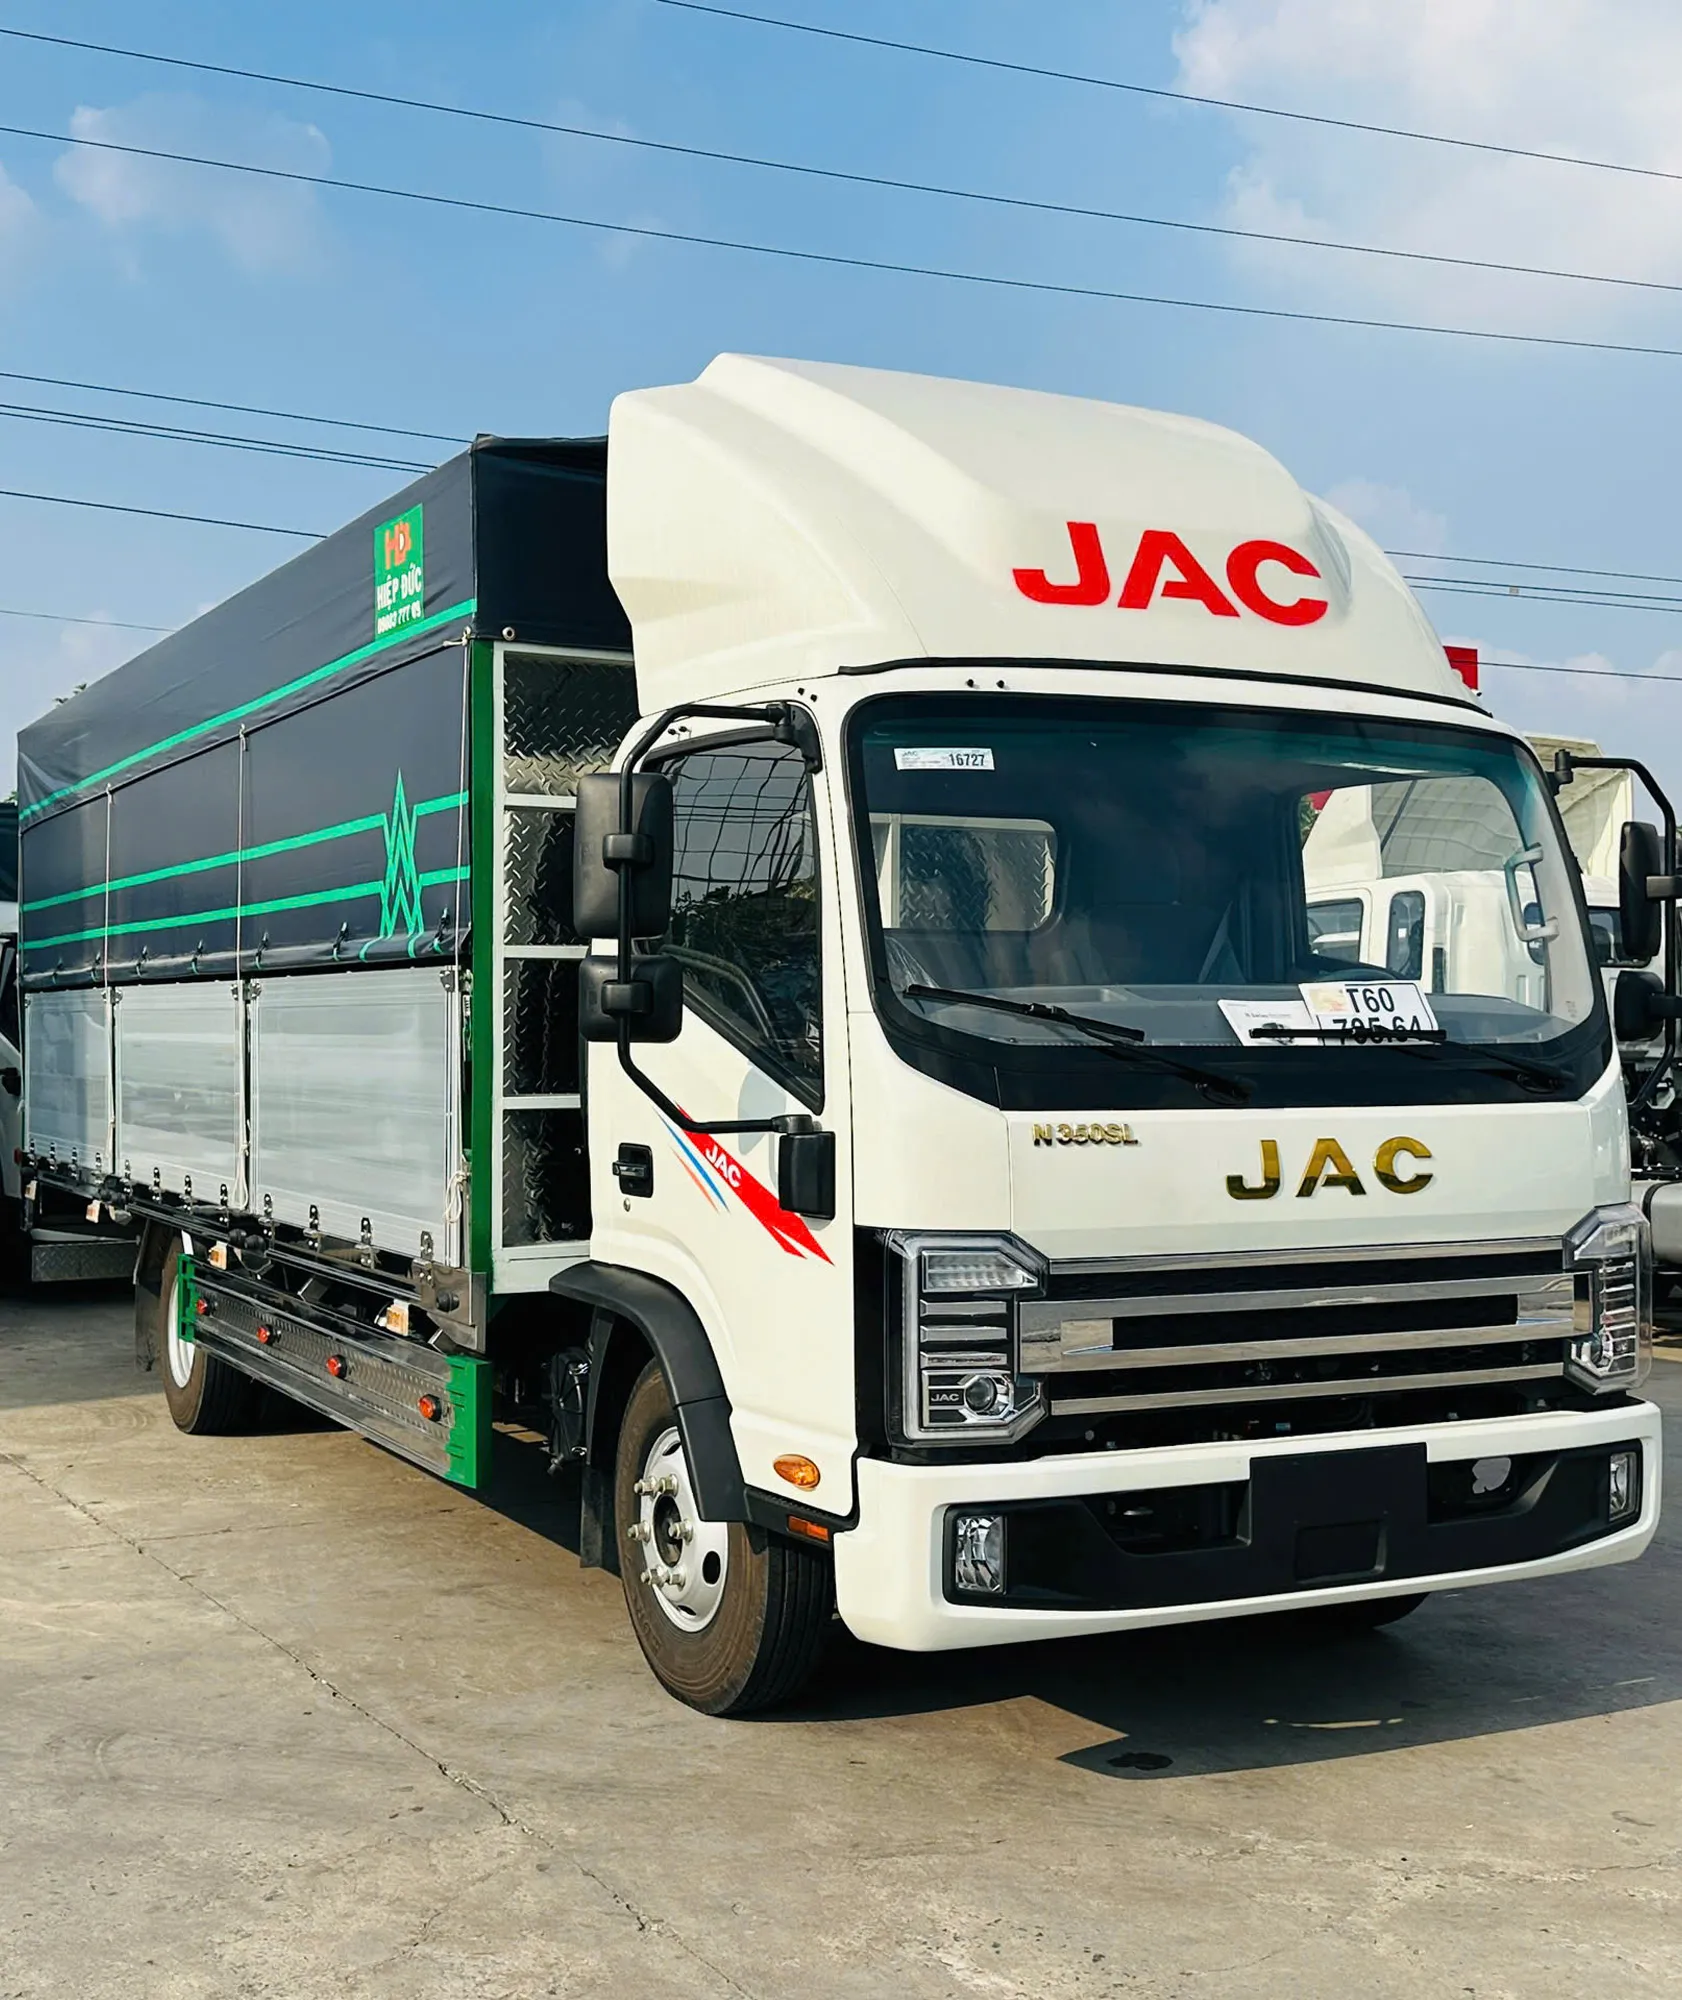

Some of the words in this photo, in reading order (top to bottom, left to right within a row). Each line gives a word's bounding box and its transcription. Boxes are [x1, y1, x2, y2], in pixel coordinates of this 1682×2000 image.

[377, 574, 399, 610] HIỆP
[400, 562, 422, 599] ĐỨC
[1012, 521, 1329, 626] JAC
[949, 753, 985, 766] 16727
[1346, 987, 1395, 1013] T60
[705, 1145, 742, 1188] JAC
[1226, 1135, 1434, 1200] JAC
[930, 1393, 960, 1402] JAC
